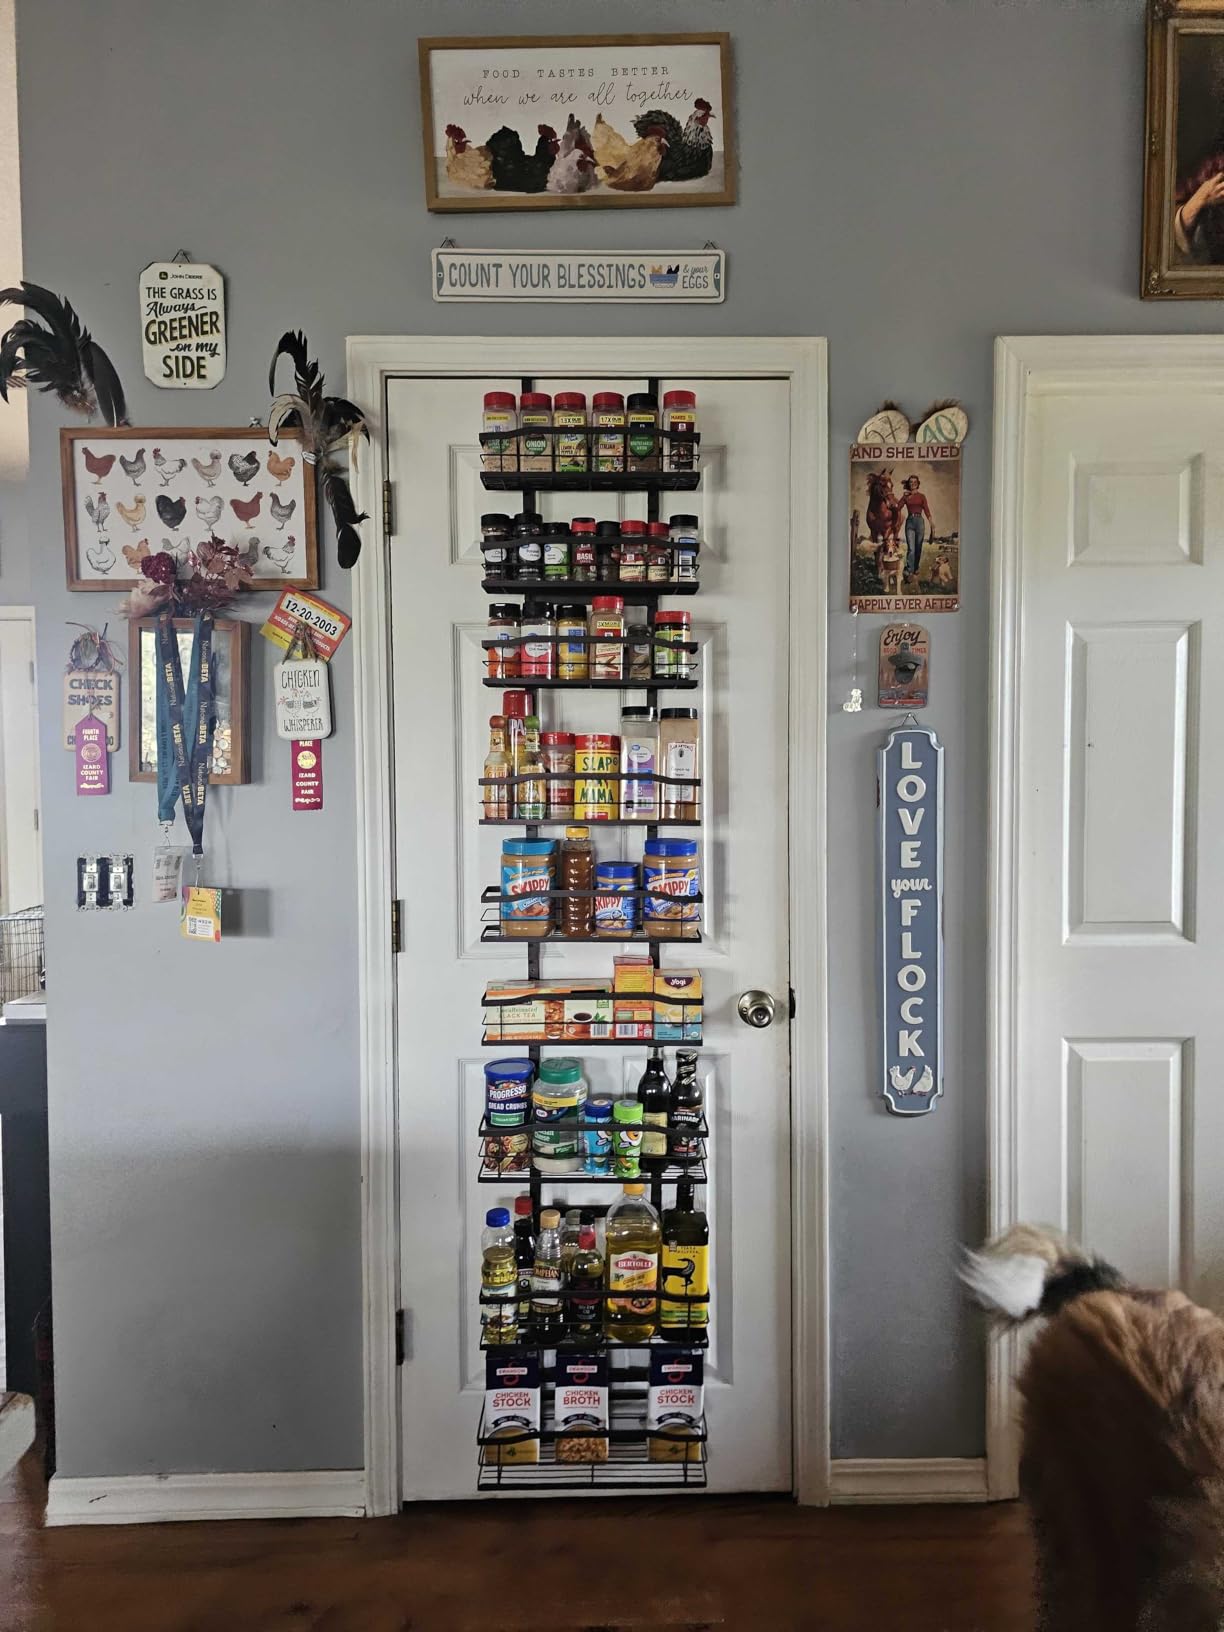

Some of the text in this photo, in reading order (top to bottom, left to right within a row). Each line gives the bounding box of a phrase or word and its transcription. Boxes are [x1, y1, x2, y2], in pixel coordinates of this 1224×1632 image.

[482, 66, 670, 79] FOOD TASTES BETTER
[463, 80, 694, 107] when we are all together
[448, 262, 646, 289] COUNT YOUR BLESSINGS
[682, 275, 709, 289] EGGS
[146, 286, 217, 301] THE GRASS IS
[146, 301, 207, 319] Always
[145, 311, 220, 345] GREENER
[169, 342, 220, 357] on my
[162, 355, 207, 380] SIDE
[526, 440, 546, 448] ONION
[851, 445, 960, 459] AND SHE LIVED
[576, 552, 594, 561] BASIL
[849, 598, 959, 610] HAPPILY EVER AFTER
[286, 599, 338, 636] 12-20-2003
[883, 629, 926, 646] Enjoy
[165, 662, 174, 684] BETA
[281, 669, 320, 689] CHICKEN
[69, 678, 113, 690] CHECK
[67, 694, 113, 706] SHOES
[283, 717, 324, 732] WHISPERER
[173, 723, 182, 744] BETA
[199, 724, 207, 745] BETA
[582, 756, 612, 771] SLAP
[197, 786, 205, 806] BETA
[896, 742, 927, 868] LOVE
[511, 877, 549, 895] SKIPPY
[891, 877, 932, 898] your
[897, 899, 927, 1057] FLOCK
[489, 1085, 527, 1099] PROGRESSO
[488, 1101, 527, 1110] BREAD CRUMBS
[492, 1398, 531, 1408] STOCK
[563, 1396, 601, 1405] BROTH
[656, 1395, 695, 1404] STOCK
